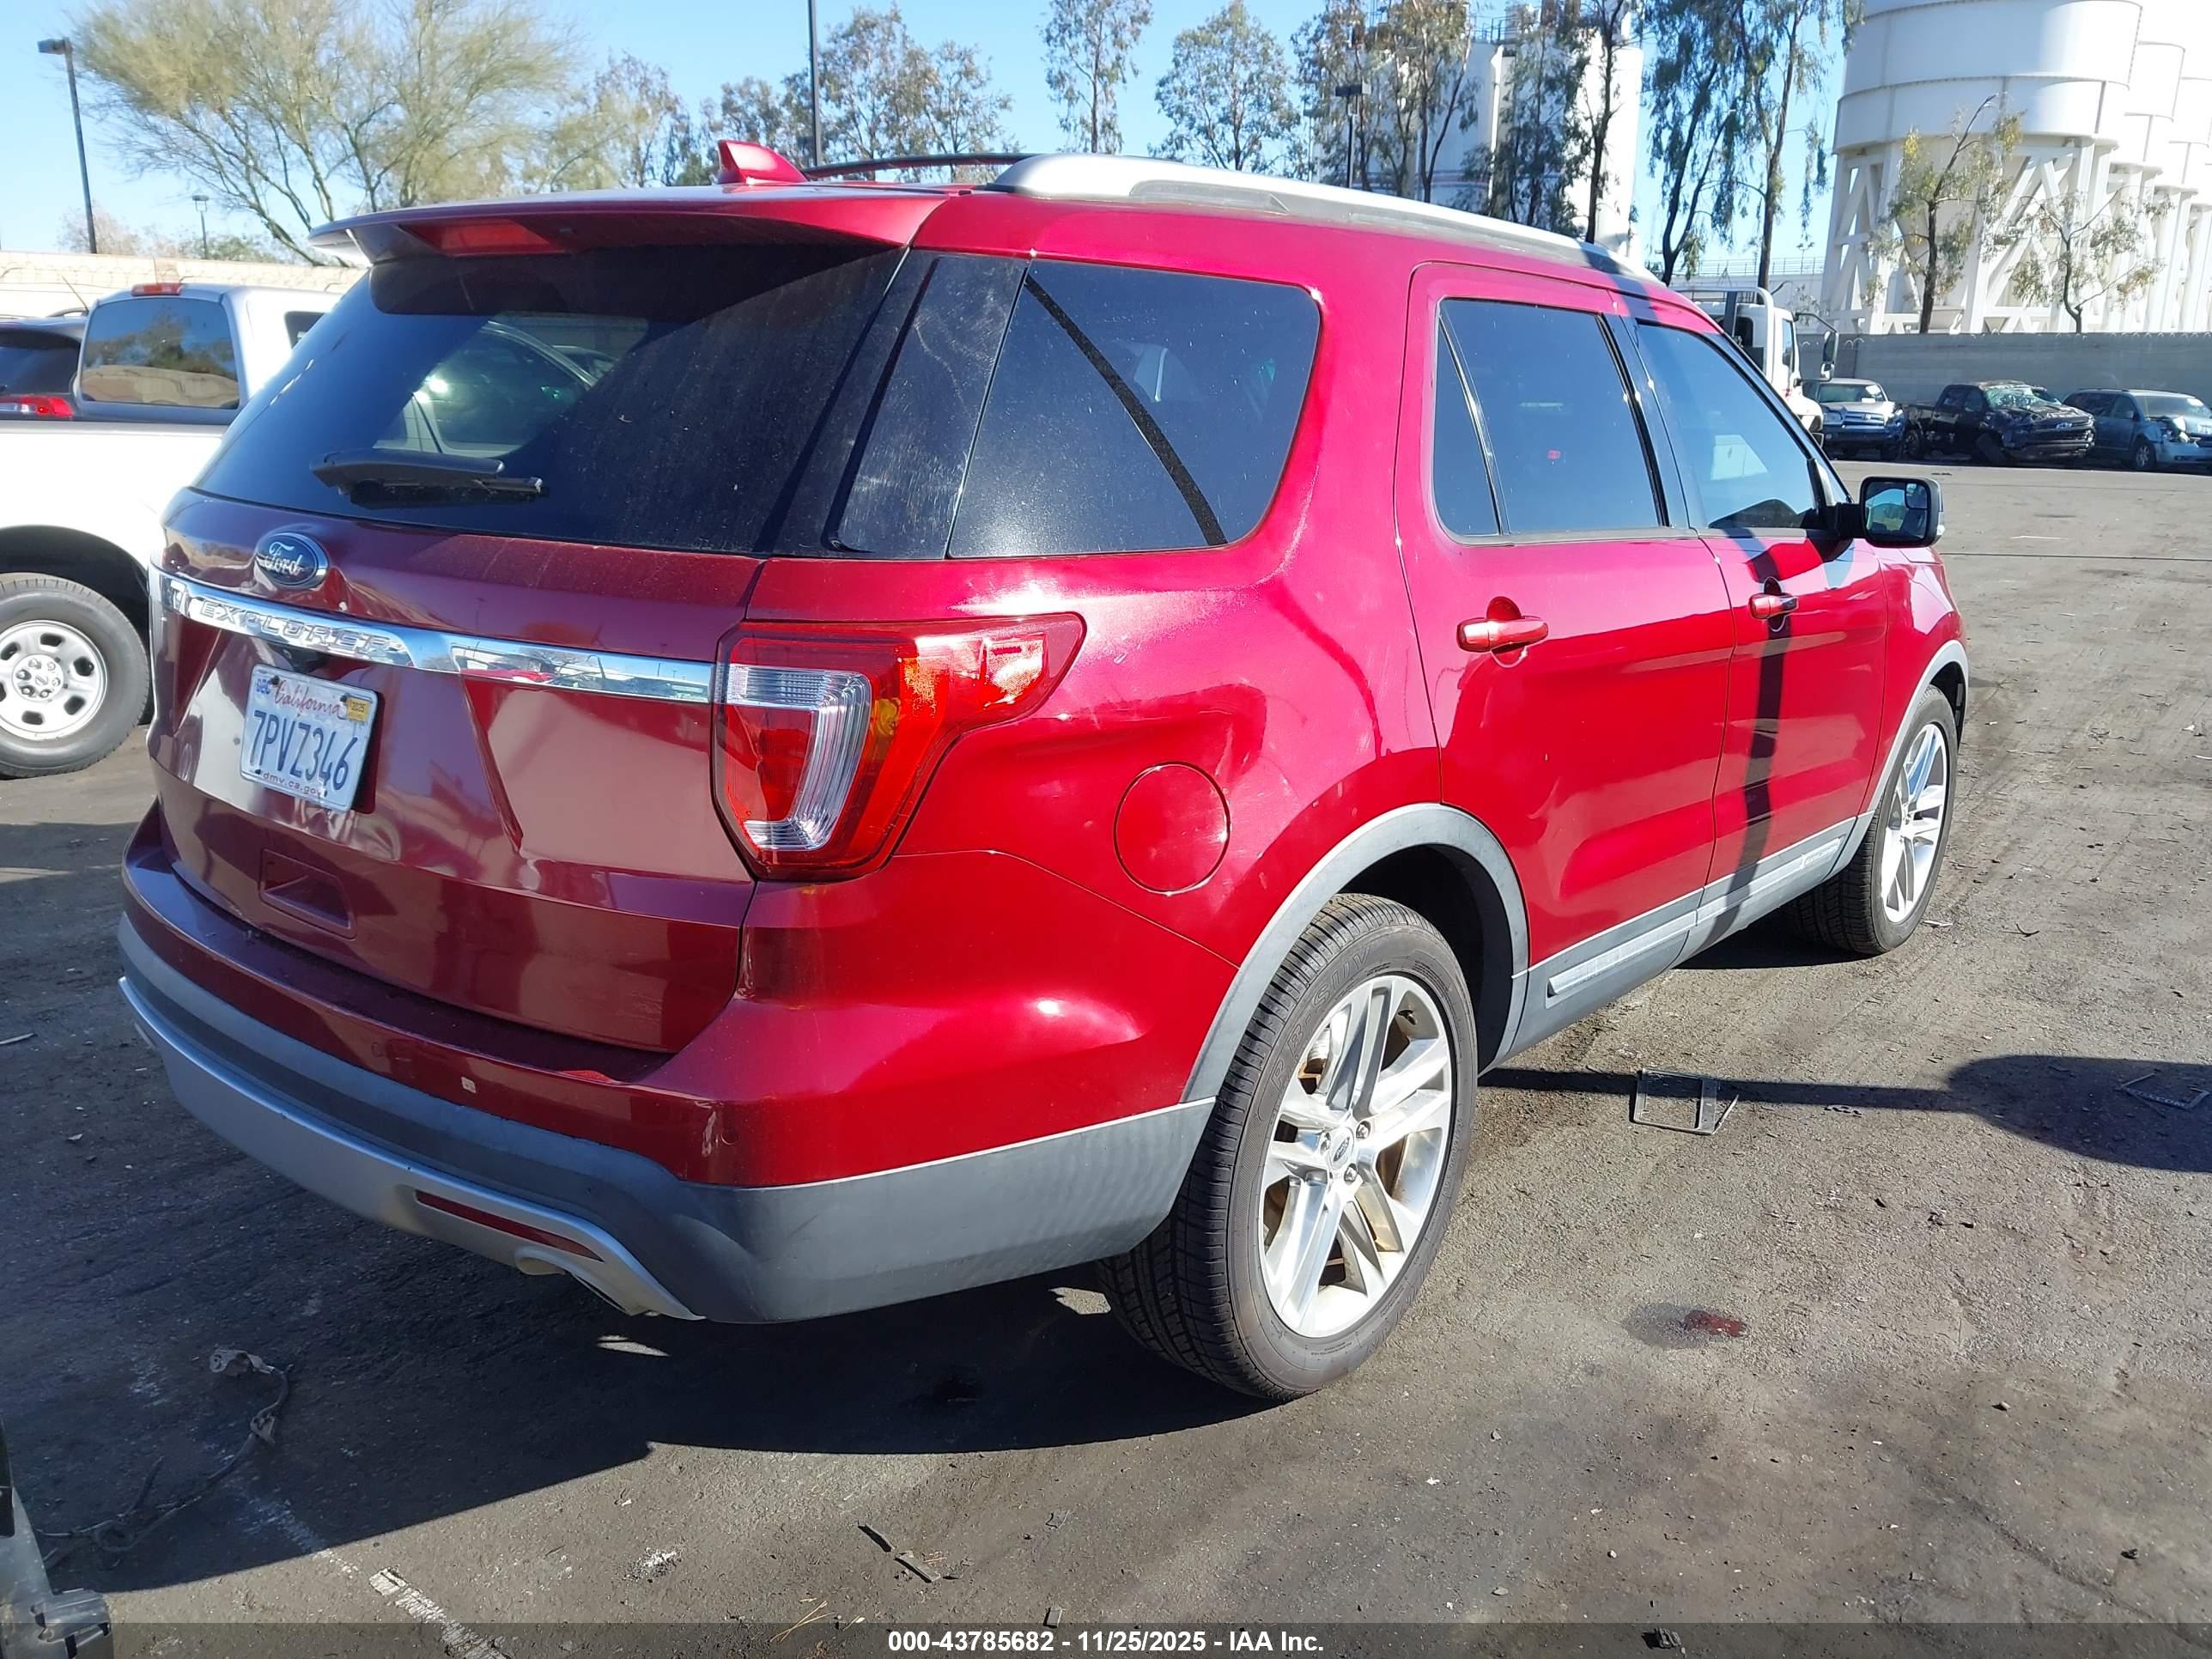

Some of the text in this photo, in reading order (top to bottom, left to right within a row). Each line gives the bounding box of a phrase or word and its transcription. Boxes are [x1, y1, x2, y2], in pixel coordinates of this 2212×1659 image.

[264, 542, 303, 576] Ford
[201, 599, 394, 655] EXPLORER
[274, 679, 348, 720] California
[250, 709, 358, 791] 7PVZ346
[263, 772, 323, 799] dmv.ca.gov
